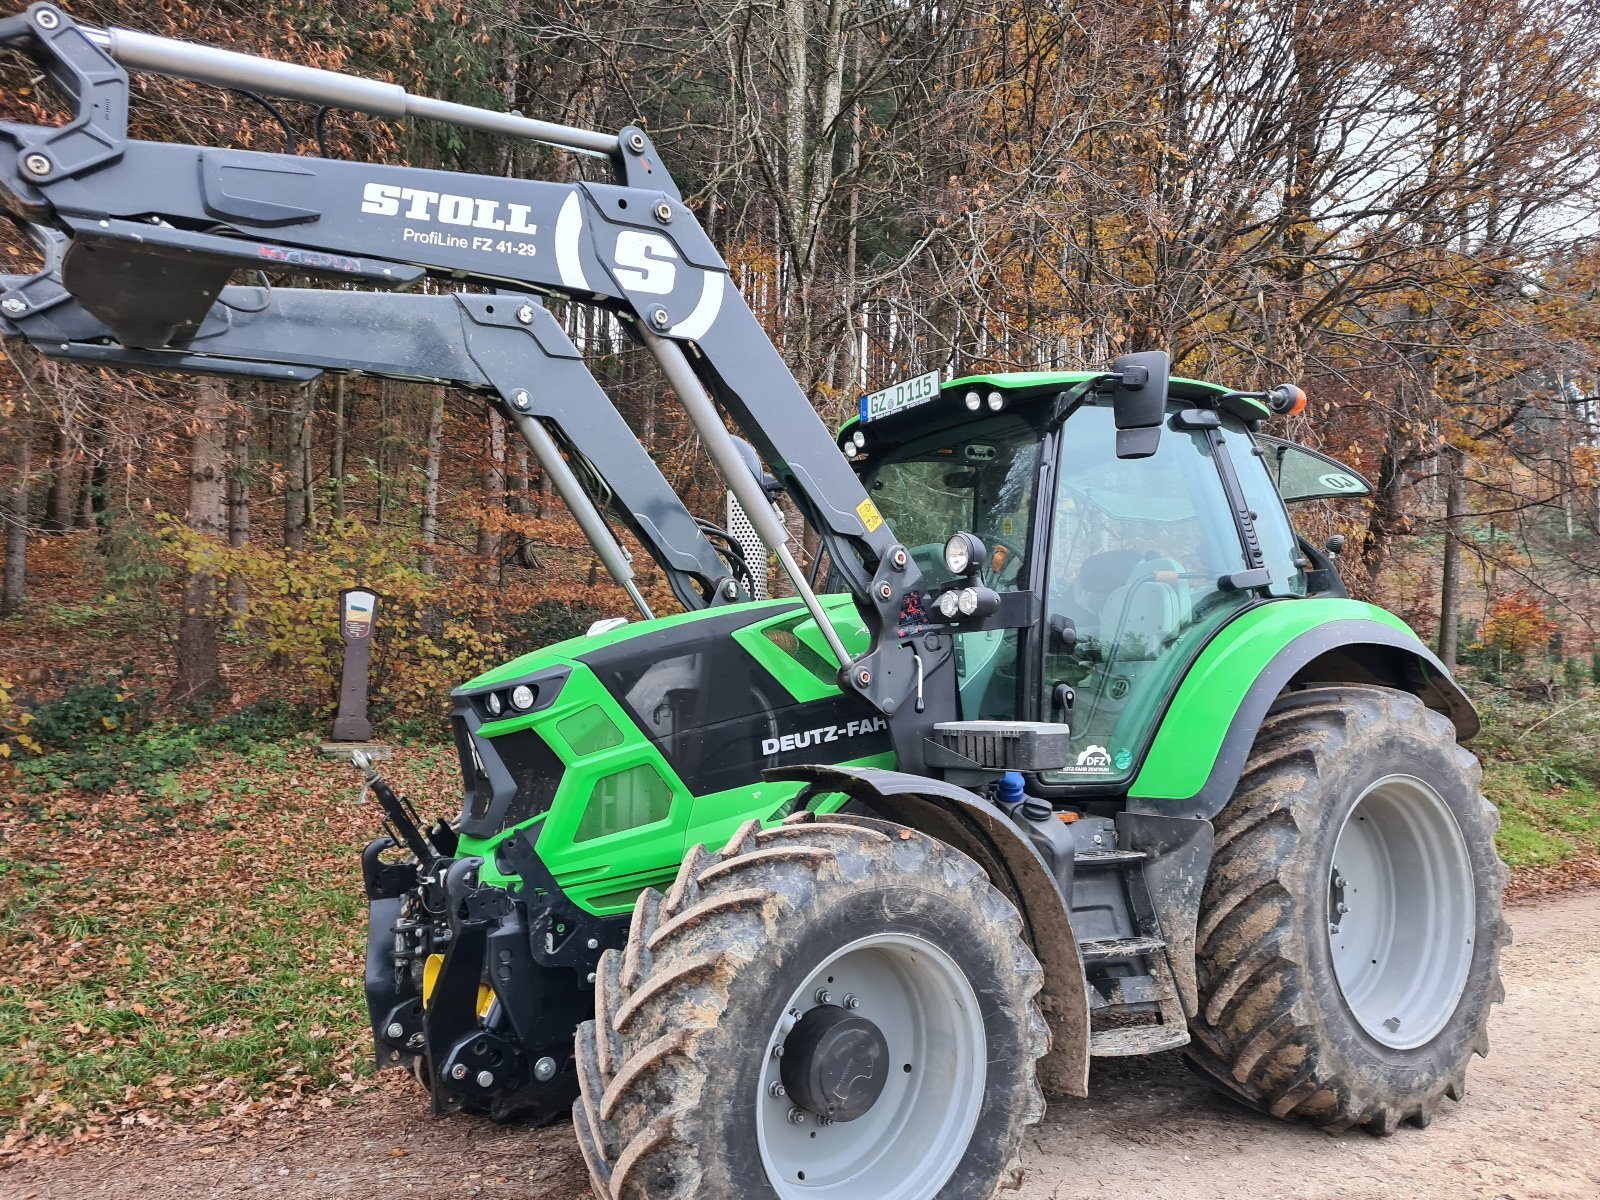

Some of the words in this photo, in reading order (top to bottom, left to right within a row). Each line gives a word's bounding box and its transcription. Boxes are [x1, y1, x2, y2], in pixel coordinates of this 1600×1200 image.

[361, 182, 537, 235] STOLL
[403, 227, 469, 249] ProfiLine
[472, 236, 493, 252] FZ
[496, 240, 536, 257] 41-29
[612, 230, 678, 295] S
[870, 392, 886, 414] GZ
[1086, 756, 1106, 766] DFZ
